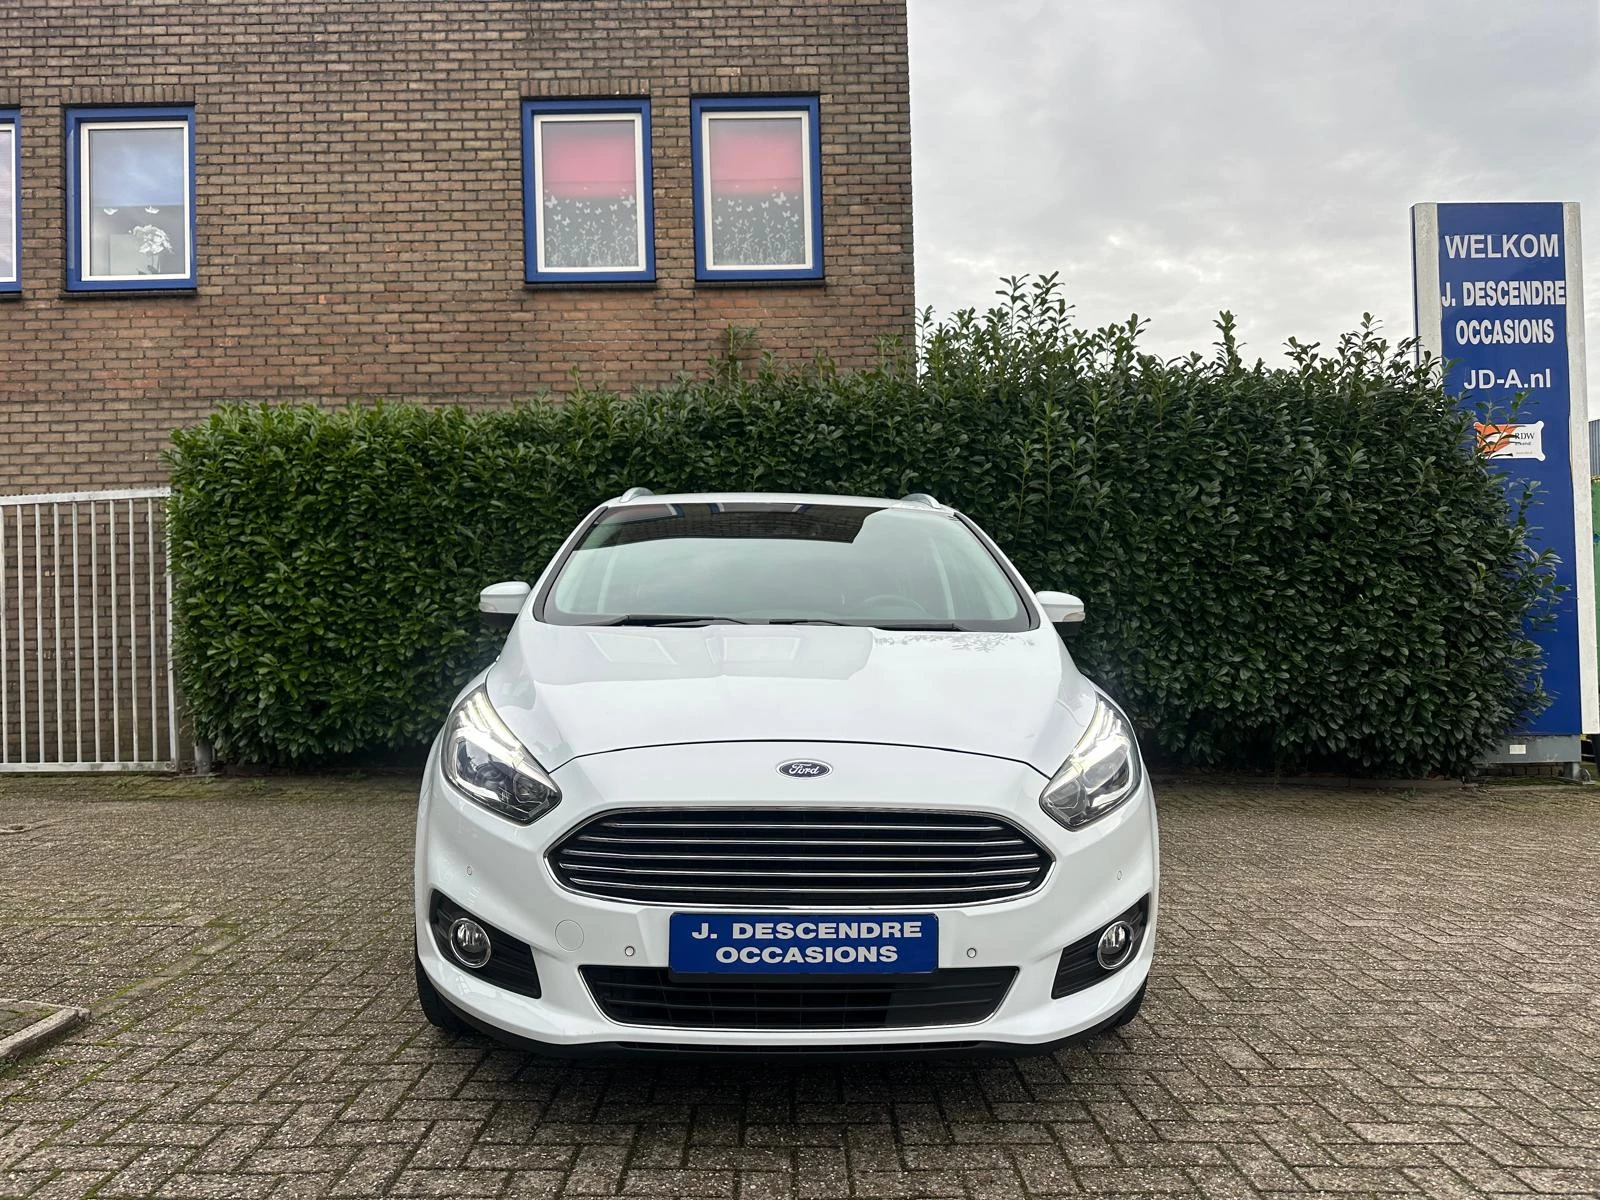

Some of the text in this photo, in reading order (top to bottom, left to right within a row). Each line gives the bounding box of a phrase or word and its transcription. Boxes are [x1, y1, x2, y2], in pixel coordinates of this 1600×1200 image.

[1445, 234, 1559, 258] WELKOM
[1441, 280, 1566, 307] J. DESCENDRE
[1455, 319, 1555, 344] OCCASIONS
[1463, 368, 1551, 389] JD-A.nl
[1515, 432, 1535, 440] RDW
[788, 763, 820, 775] Ford
[691, 921, 922, 940] J. DESCENDRE
[715, 945, 898, 964] OCCASIONS
